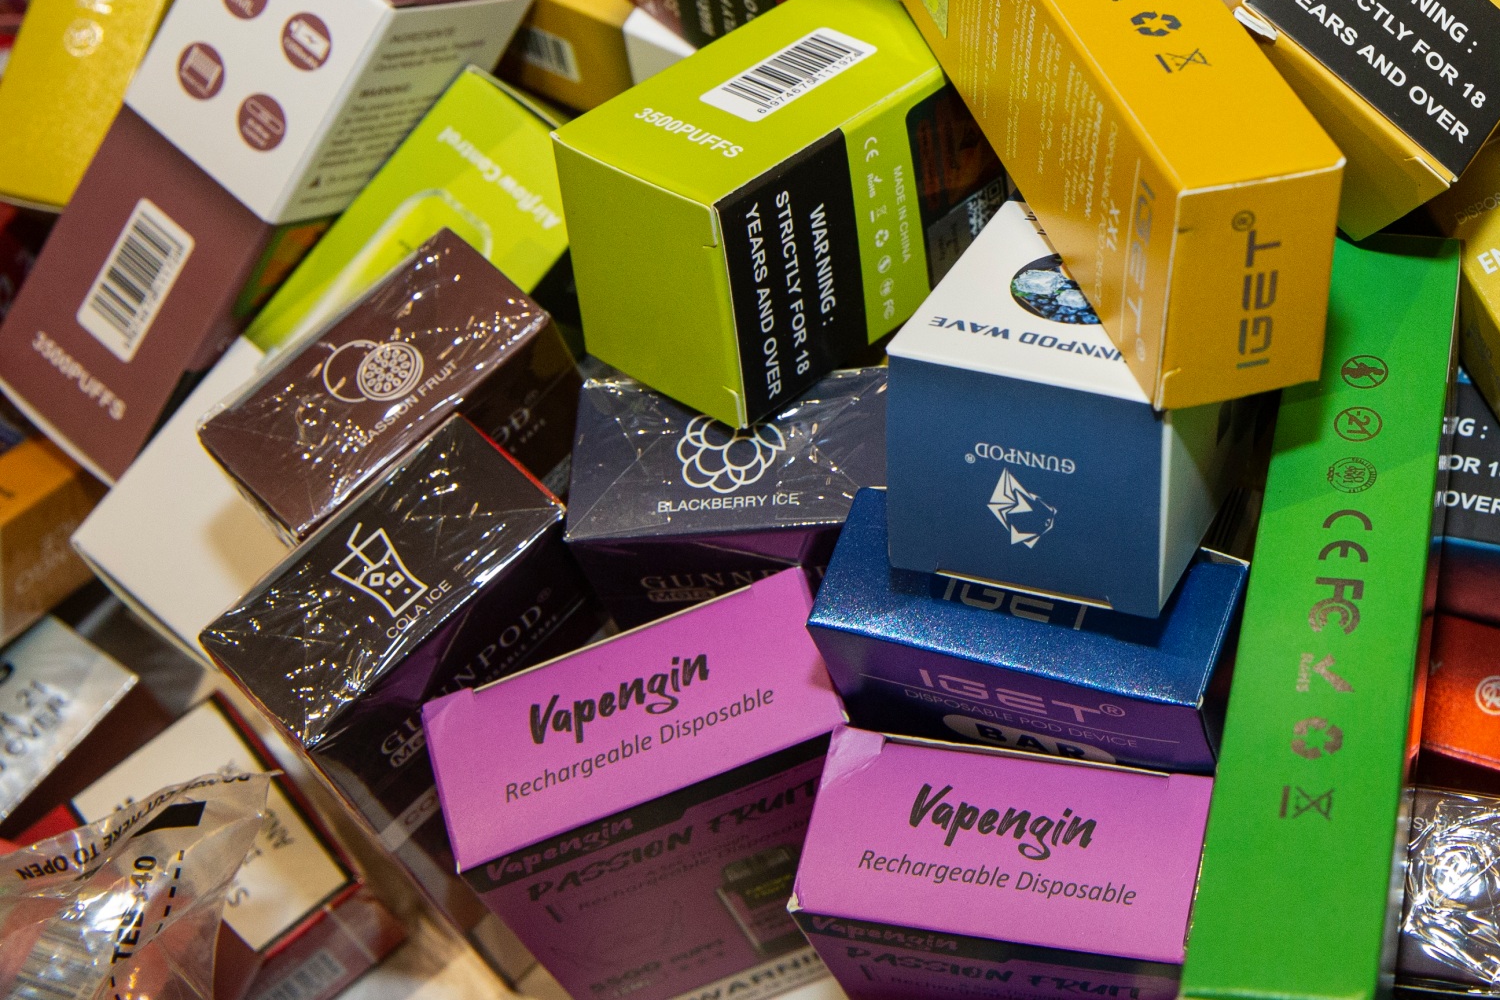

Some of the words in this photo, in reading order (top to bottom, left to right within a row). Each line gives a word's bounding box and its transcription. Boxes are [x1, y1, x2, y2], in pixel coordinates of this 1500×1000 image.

[1356, 44, 1407, 87] AND
[1409, 85, 1469, 144] OVER
[1411, 39, 1459, 86] FOR
[1462, 83, 1486, 108] 18
[634, 108, 744, 158] 3500PUFFS
[745, 202, 769, 282] YEARS
[775, 190, 802, 296] STRICTLY
[809, 203, 836, 316] WARNING
[756, 290, 775, 333] AND
[789, 299, 806, 348] FOR
[929, 315, 1010, 340] WAVE
[763, 340, 782, 400] OVER
[795, 354, 810, 375] 18
[656, 497, 768, 514] BLACKBERRY
[769, 492, 799, 507] ICE
[385, 606, 428, 640] COLA
[424, 579, 453, 606] ICE
[529, 653, 709, 744] Vapengin
[905, 689, 1014, 722] DISPOSABLE
[1020, 715, 1062, 733] POD
[1068, 724, 1137, 748] DEVICE
[505, 735, 652, 803] Rechargeable
[659, 689, 774, 745] Disposable
[909, 783, 1097, 861] Vapengin
[16, 857, 69, 881] OPEN
[858, 849, 1010, 888] Rechargeable
[1015, 871, 1137, 906] Disposable
